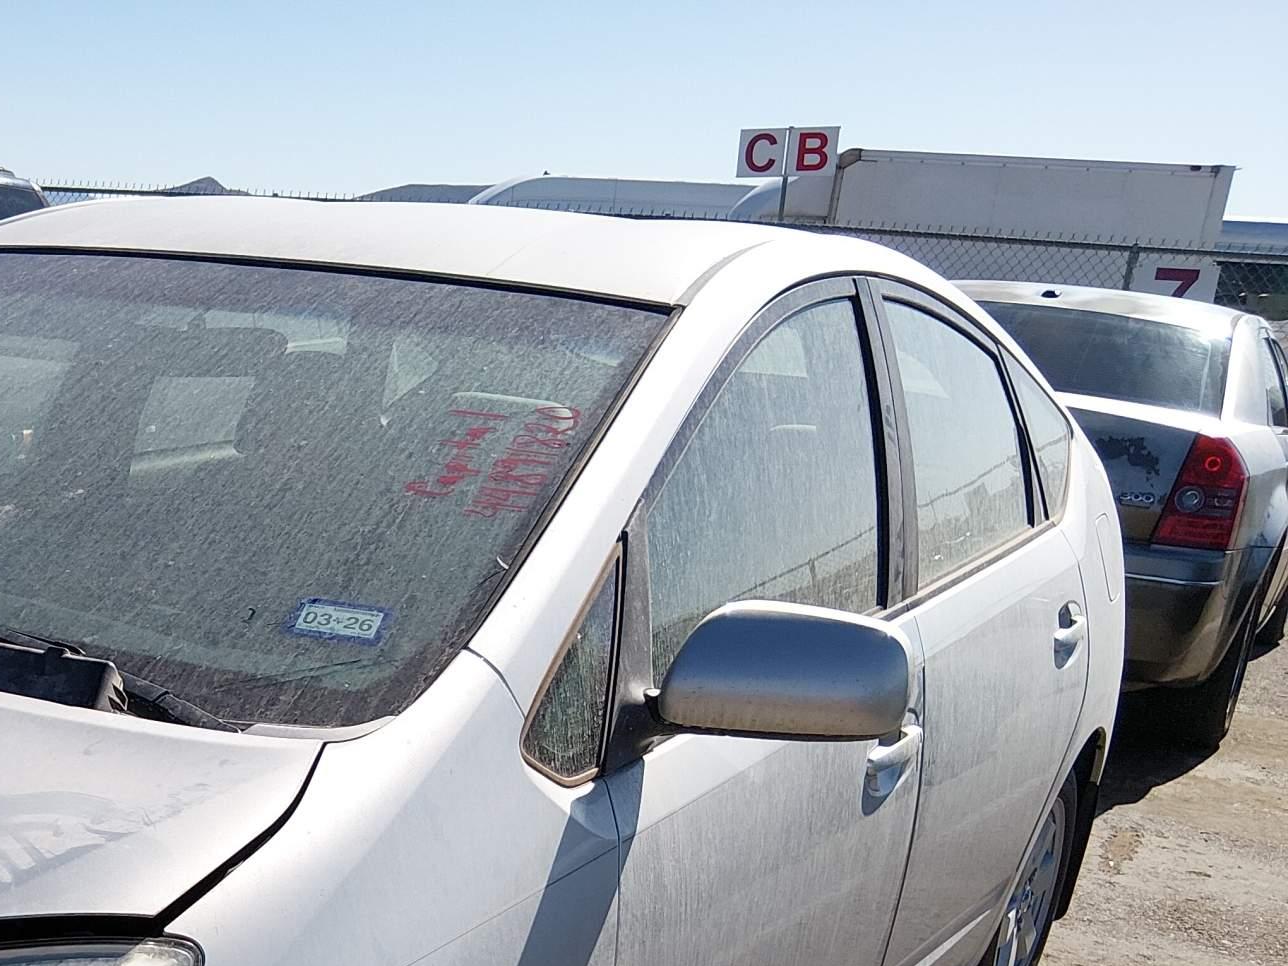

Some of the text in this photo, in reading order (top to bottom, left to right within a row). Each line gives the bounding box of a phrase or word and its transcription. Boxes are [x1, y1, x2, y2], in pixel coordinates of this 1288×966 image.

[745, 133, 778, 173] C
[796, 132, 829, 171] B
[1154, 267, 1201, 298] 7
